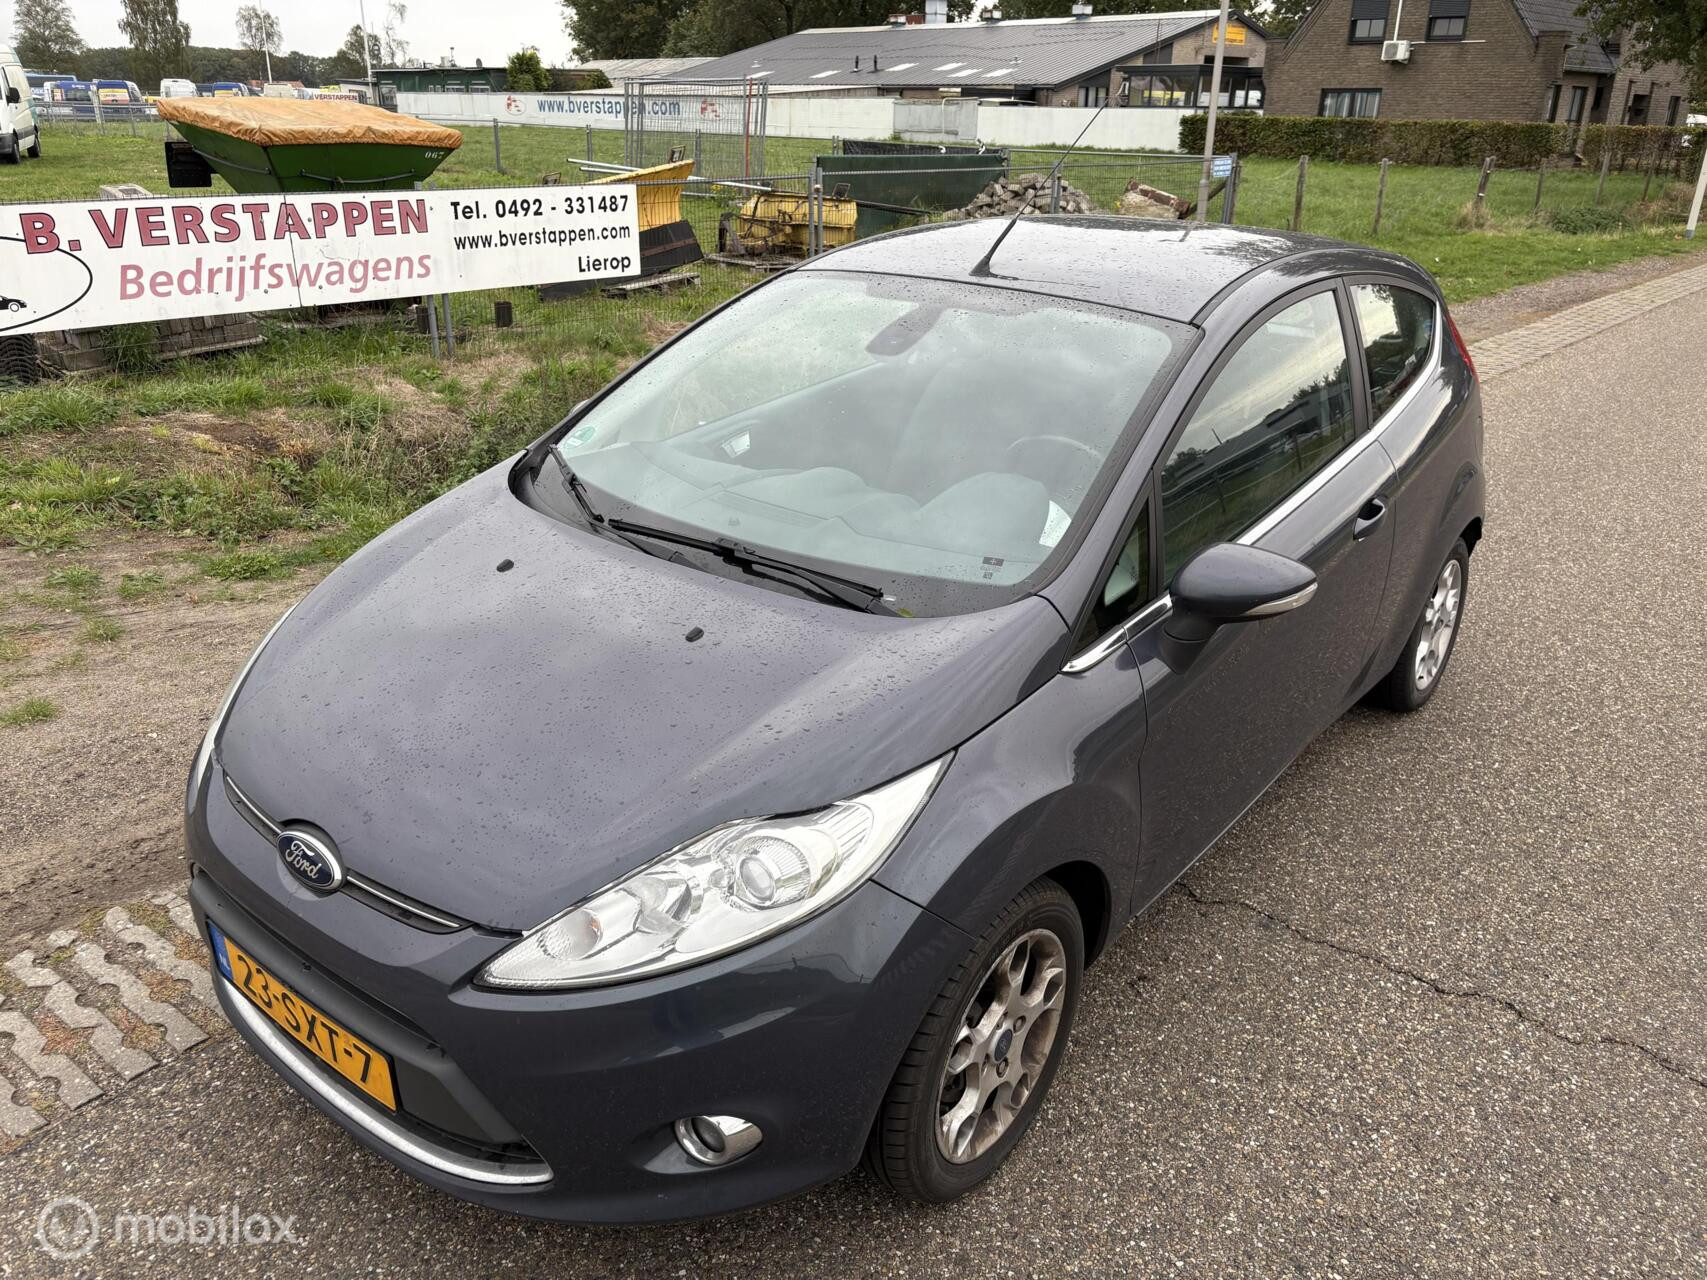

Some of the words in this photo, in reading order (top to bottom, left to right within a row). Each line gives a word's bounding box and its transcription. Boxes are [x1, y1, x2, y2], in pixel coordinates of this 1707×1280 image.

[19, 212, 82, 255] B.
[88, 198, 429, 249] VERSTAPPEN
[450, 200, 487, 220] Tel.
[495, 199, 543, 218] 0492
[564, 195, 629, 214] 331487
[453, 225, 631, 250] www.bverstappen.com
[119, 253, 432, 302] Bedrijfswagens
[578, 254, 632, 273] Lierop
[286, 841, 321, 880] Ford
[236, 953, 373, 1084] 23-SXT-7
